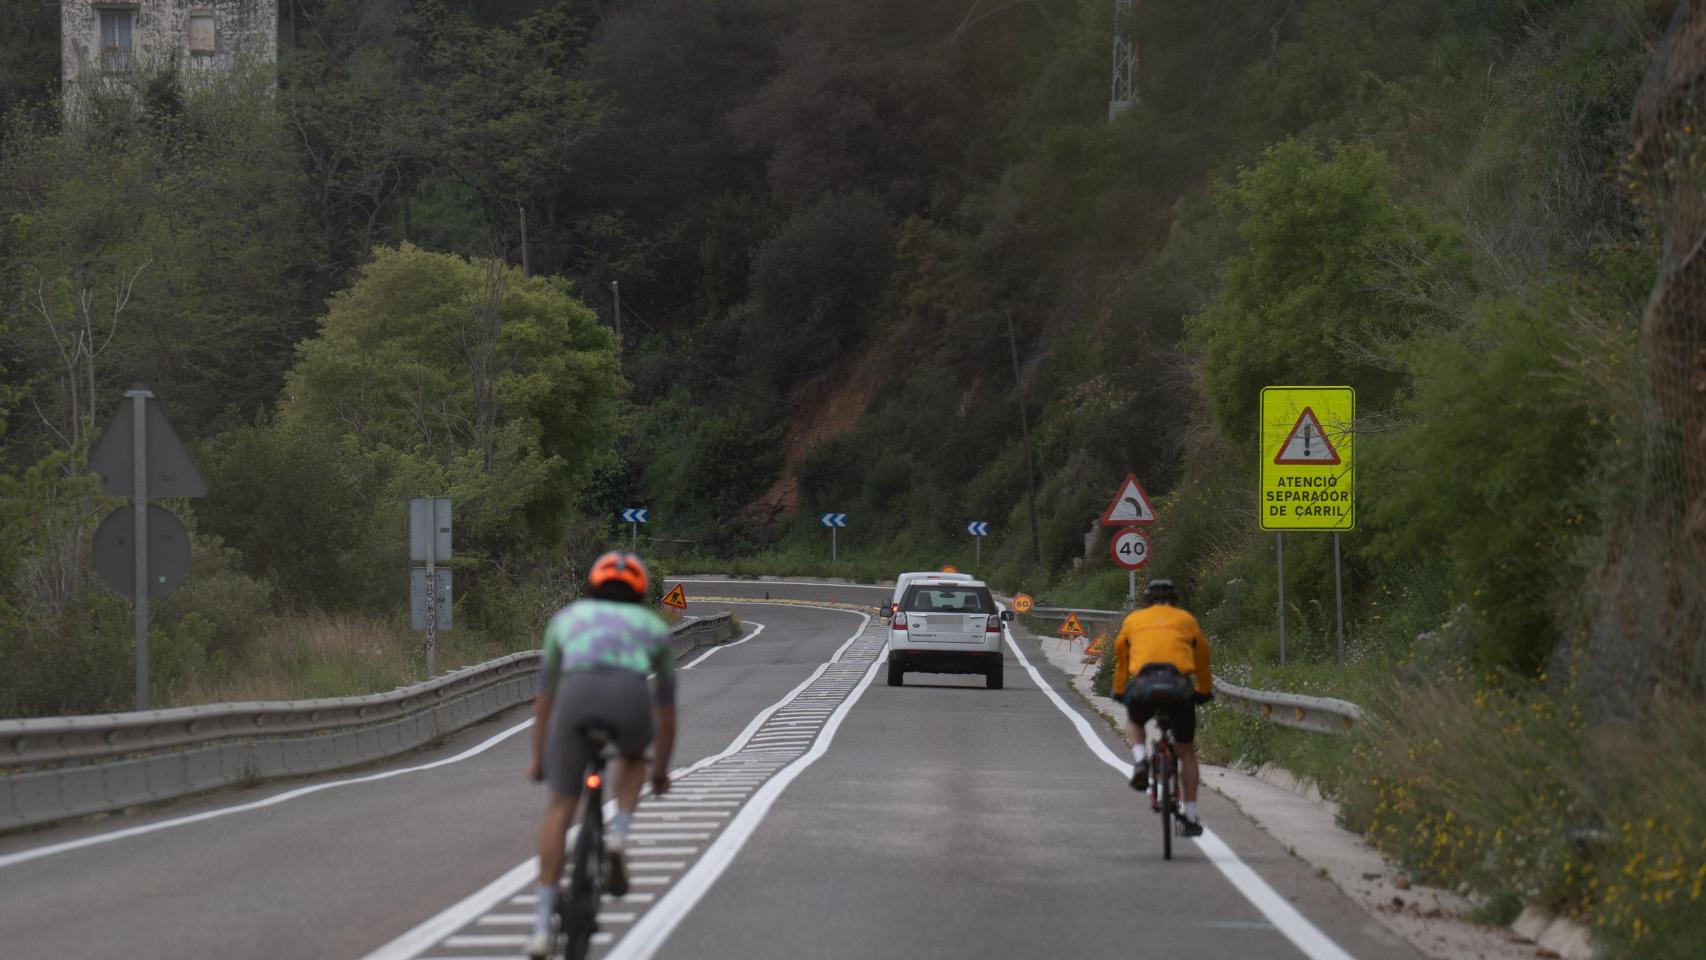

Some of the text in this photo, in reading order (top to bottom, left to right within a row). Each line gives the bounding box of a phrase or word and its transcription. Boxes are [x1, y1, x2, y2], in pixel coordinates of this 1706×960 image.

[1266, 491, 1349, 502] SEPARADOR
[1270, 505, 1344, 517] DE CARRIL
[1119, 542, 1145, 556] 40
